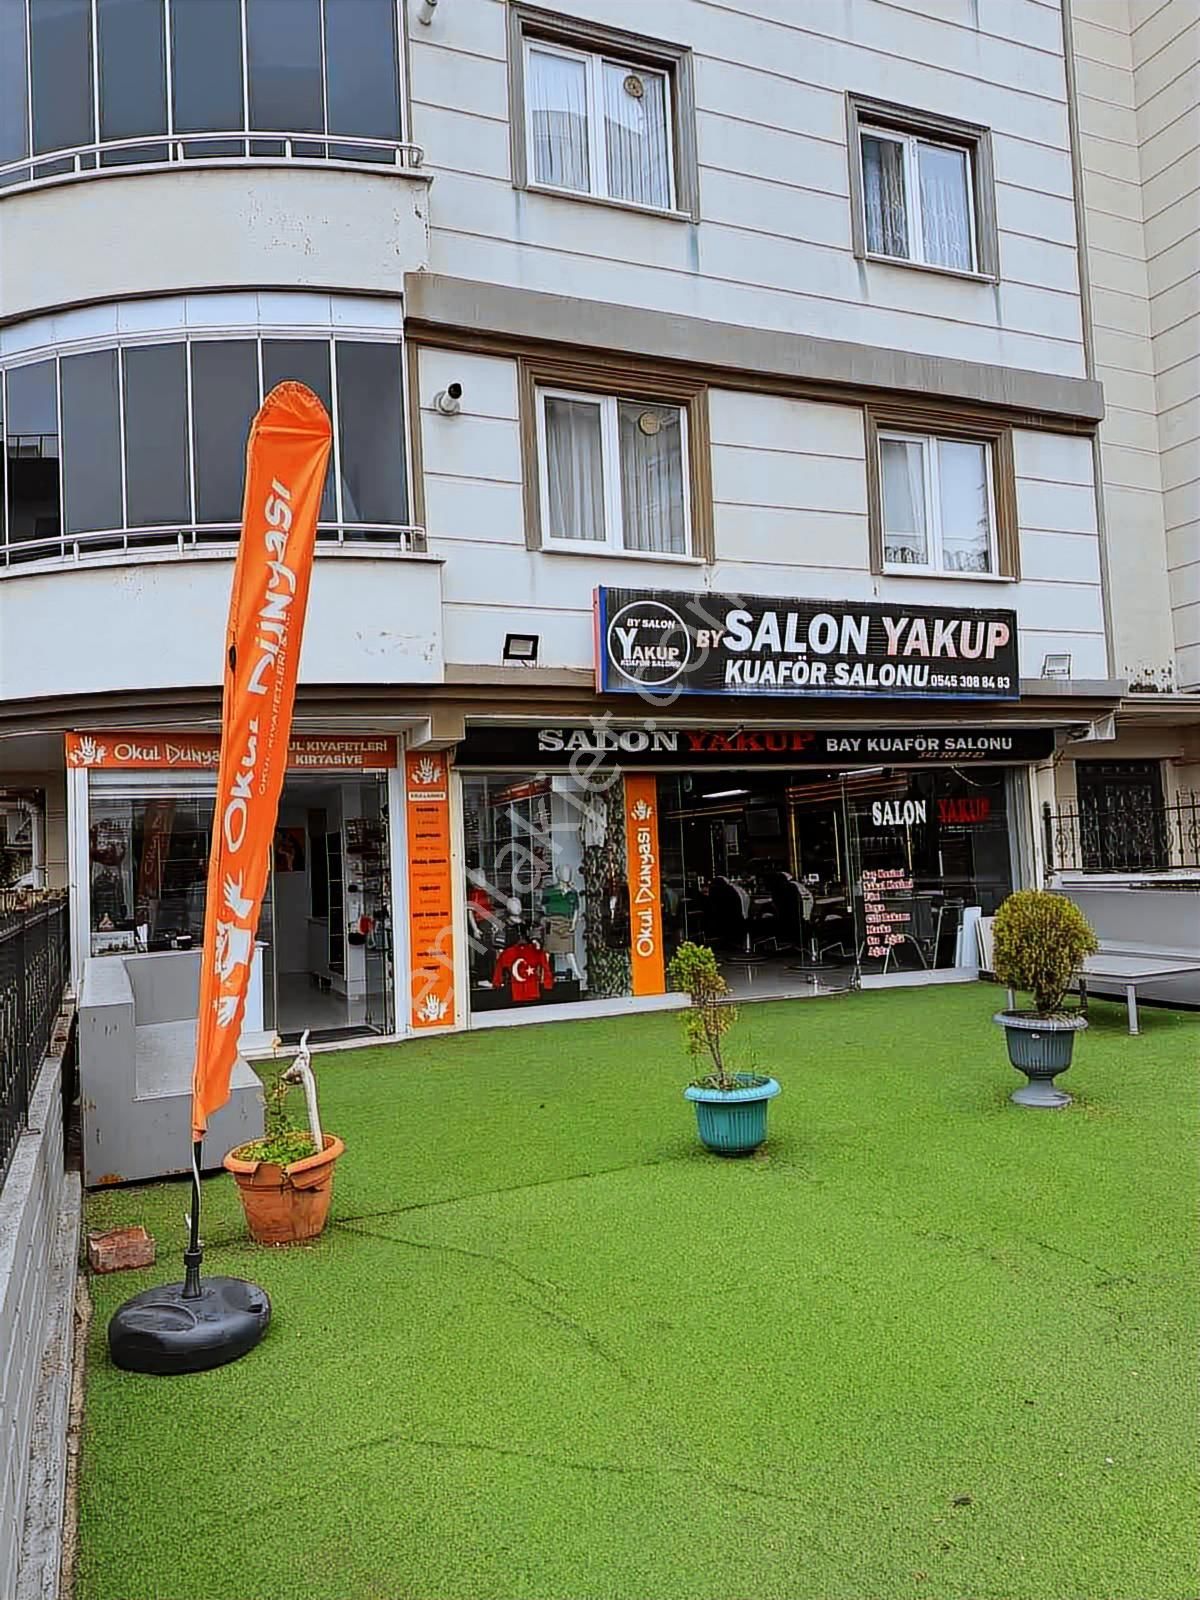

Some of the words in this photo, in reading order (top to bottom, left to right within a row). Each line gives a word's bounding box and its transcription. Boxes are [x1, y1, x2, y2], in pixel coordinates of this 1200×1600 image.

[626, 618, 641, 627] BY
[642, 619, 676, 629] SALON
[696, 629, 724, 648] BY
[722, 609, 869, 654] SALON
[881, 616, 1010, 659] YAKUP
[614, 627, 680, 660] YAKUP
[725, 655, 827, 685] KUAFÖR
[833, 662, 929, 687] SALONU
[930, 675, 957, 687] 0545
[960, 676, 979, 687] 308
[982, 677, 995, 689] 84
[307, 740, 387, 752] KIYAFETLERİ
[538, 729, 680, 752] SALON
[687, 730, 816, 752] YAKUP
[826, 738, 861, 752] BAY
[867, 735, 940, 751] KUAFÖR
[944, 737, 1012, 750] SALONU
[165, 743, 220, 765] Dünya
[296, 753, 363, 765] KIRTASİYE
[258, 753, 272, 795] OKUL
[872, 800, 927, 826] SALON
